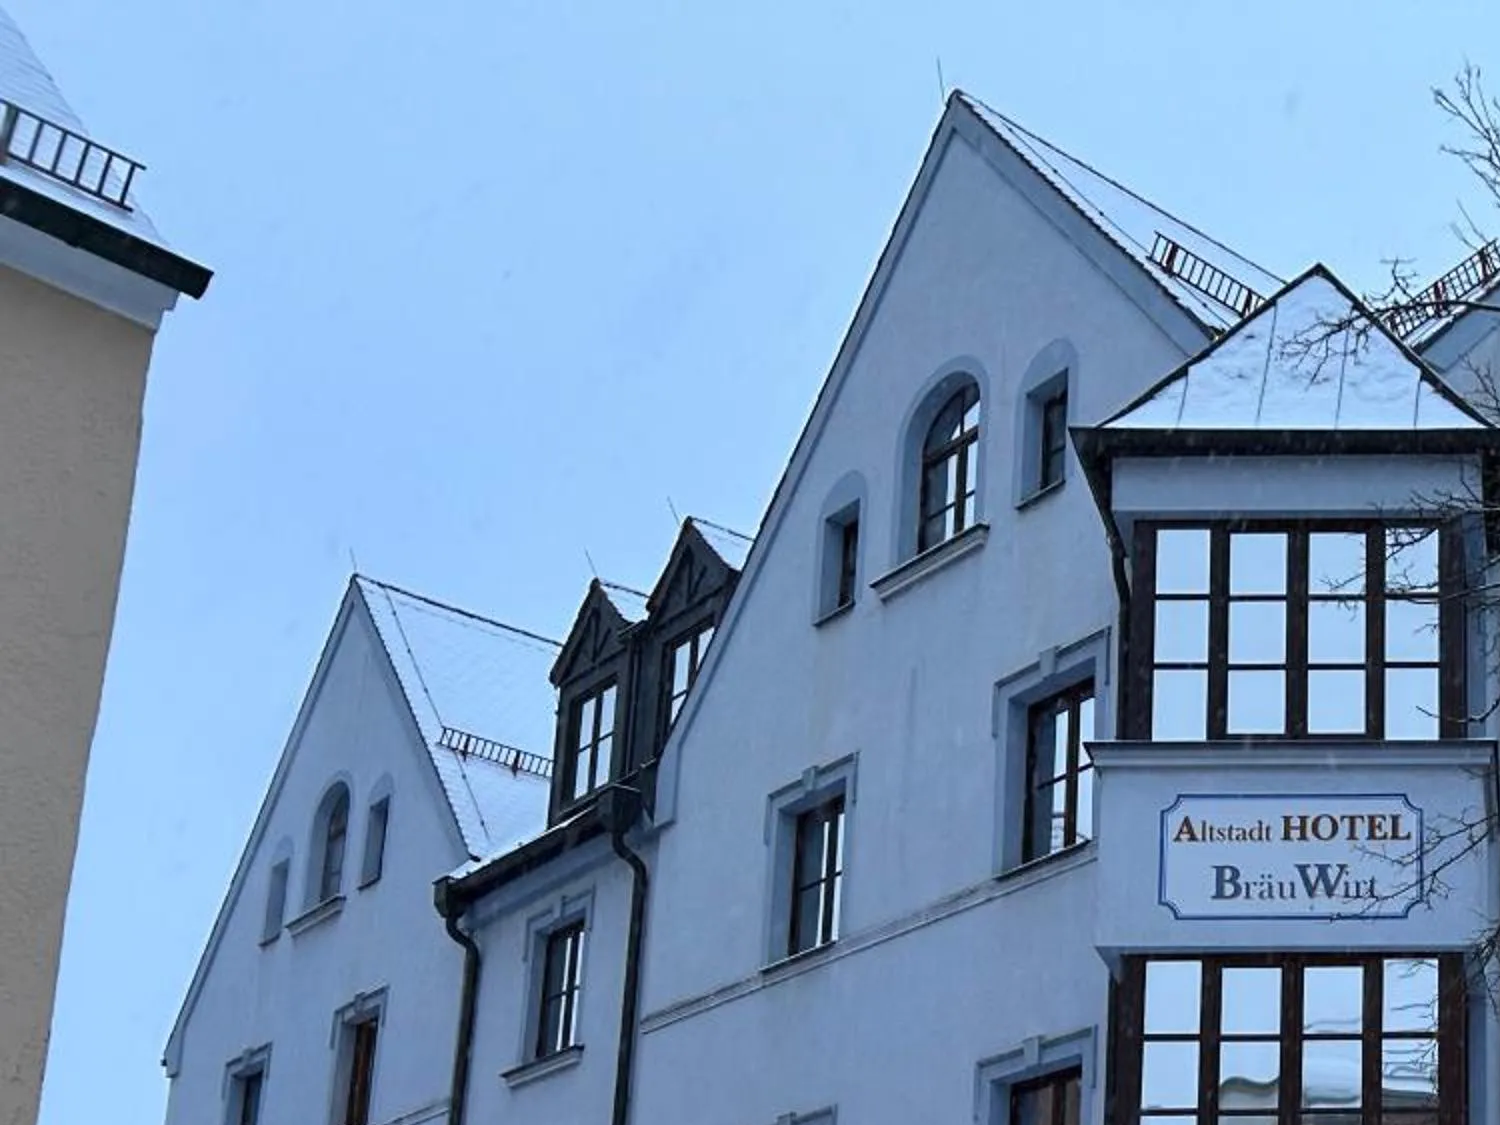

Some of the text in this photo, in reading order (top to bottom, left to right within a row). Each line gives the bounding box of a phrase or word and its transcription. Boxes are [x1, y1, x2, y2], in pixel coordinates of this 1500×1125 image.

[1173, 814, 1411, 842] Altstadt HOTEL
[1210, 864, 1377, 899] BräuWirt
